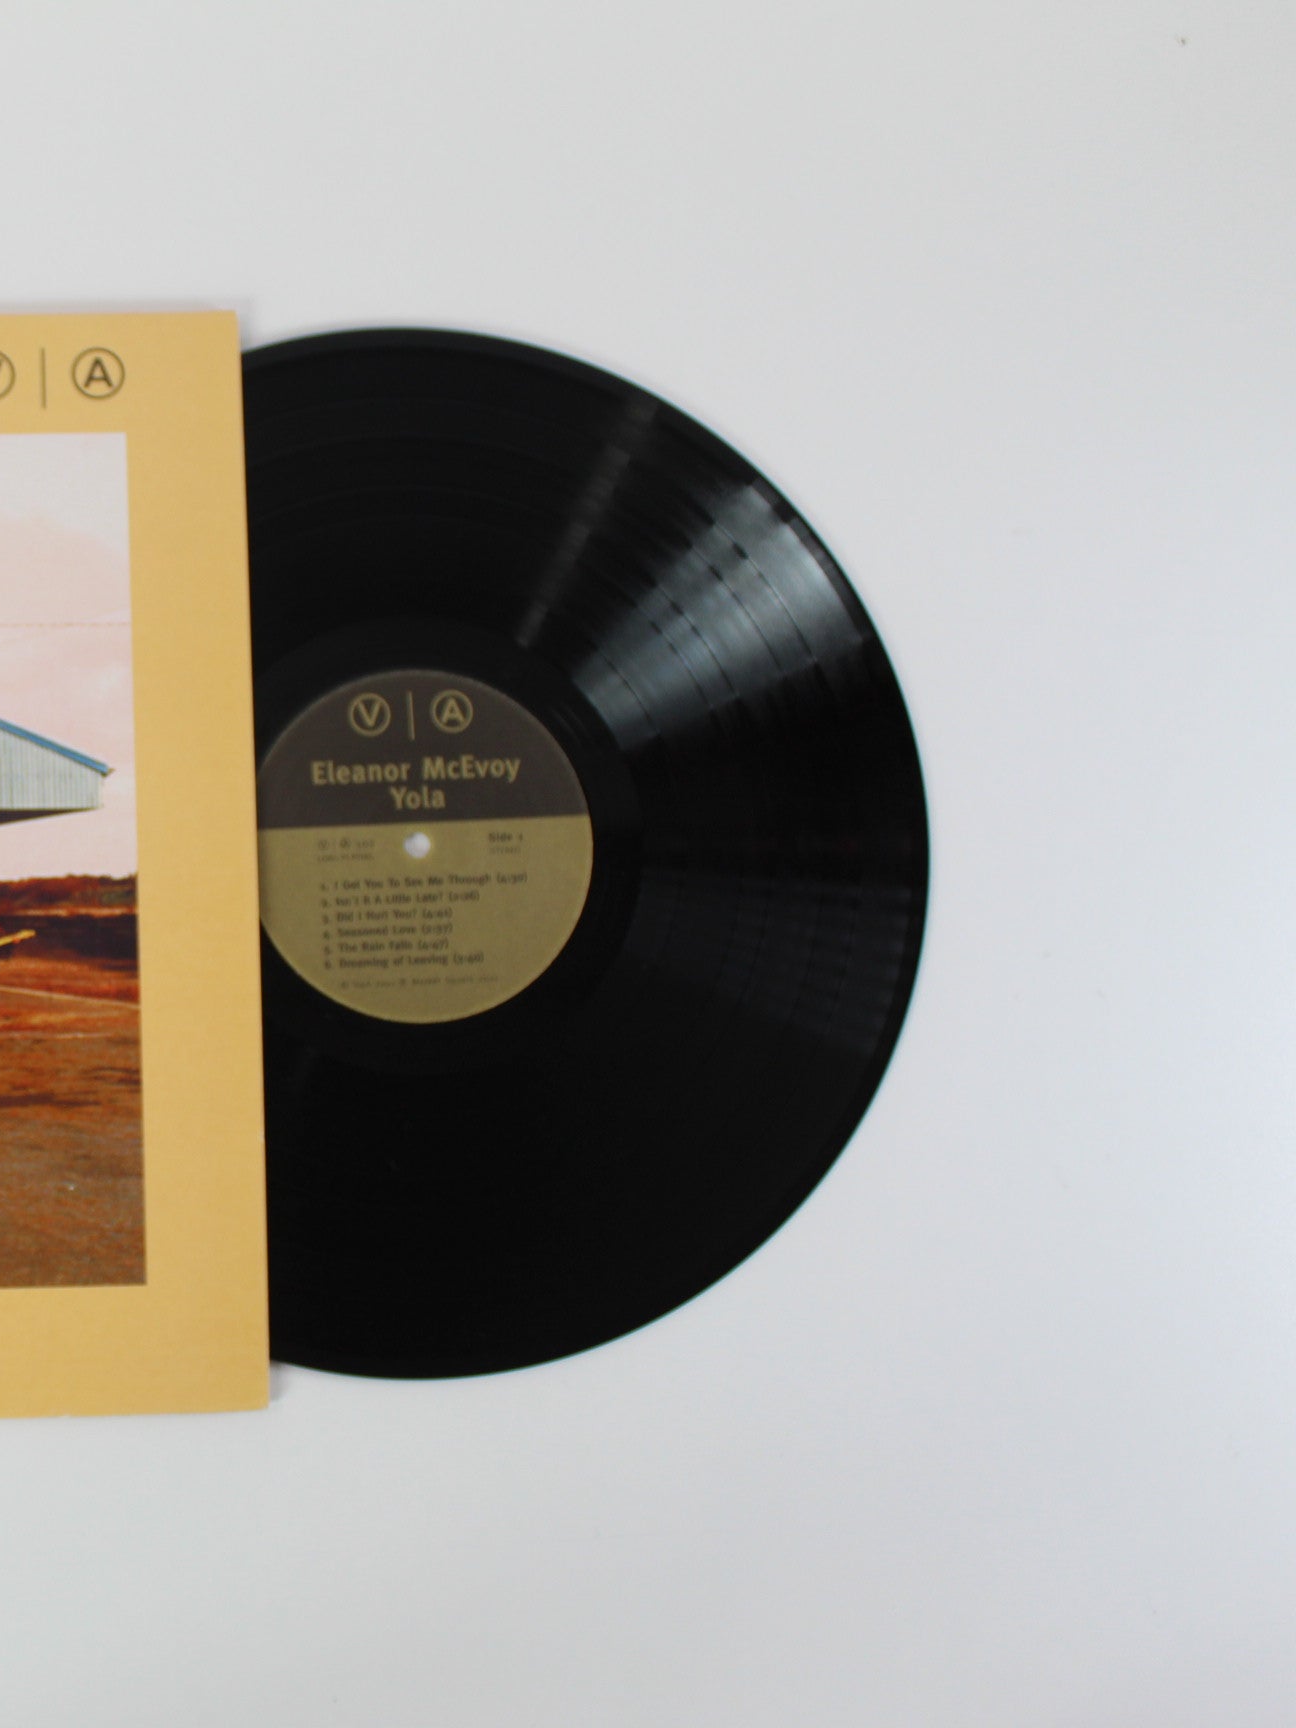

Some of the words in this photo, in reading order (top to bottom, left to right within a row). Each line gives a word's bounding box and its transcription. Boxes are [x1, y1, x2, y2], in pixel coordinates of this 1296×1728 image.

[310, 760, 410, 785] Eleanor
[421, 754, 521, 783] McEvoy
[389, 786, 446, 810] Yola
[364, 878, 384, 889] You
[387, 877, 401, 888] To
[404, 876, 423, 887] See
[427, 875, 444, 886] Me
[448, 873, 491, 887] Through
[375, 894, 382, 905] A
[385, 893, 412, 904] Little
[416, 891, 444, 903] Late?
[337, 911, 354, 922] Did
[366, 909, 389, 920] Hurt
[392, 908, 417, 919] You?
[337, 925, 389, 937] Seasoned
[392, 923, 417, 935] Love
[339, 942, 358, 953] The
[361, 940, 385, 952] Rain
[389, 939, 413, 950] Falls
[339, 956, 389, 968] Dreaming
[393, 955, 404, 966] of
[408, 953, 449, 966] Leaving
